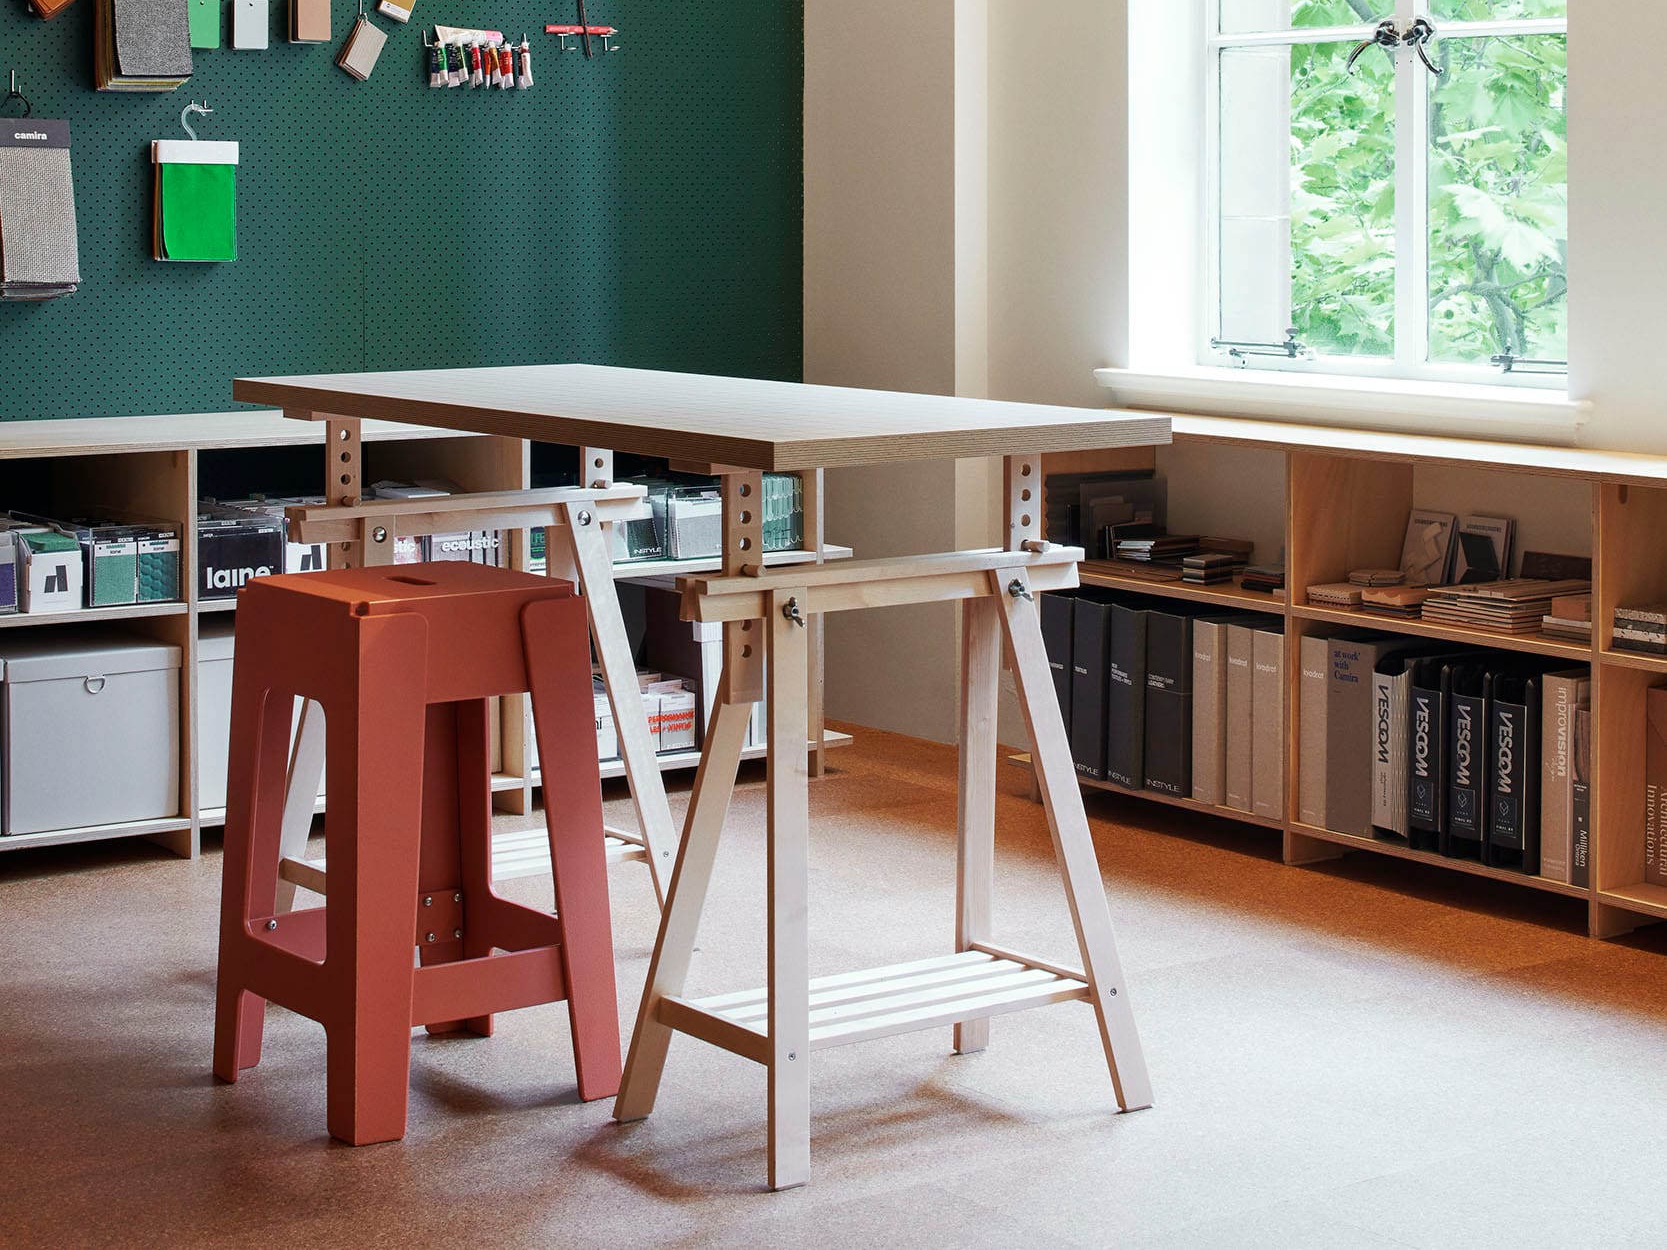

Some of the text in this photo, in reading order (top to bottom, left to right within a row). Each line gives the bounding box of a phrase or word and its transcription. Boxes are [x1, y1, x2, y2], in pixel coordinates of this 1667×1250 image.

[14, 131, 48, 140] camira
[441, 537, 499, 553] ecoustic
[1334, 670, 1359, 682] Camira
[1378, 685, 1389, 763] VESCOM
[1416, 697, 1429, 777] VESCOM
[1457, 704, 1471, 785] VESCOM
[1498, 712, 1513, 793] VESCOM
[1556, 687, 1568, 777] improvision
[1146, 779, 1181, 792] INSTYLE
[1647, 784, 1657, 865] Innovations
[1579, 830, 1588, 867] Milliken
